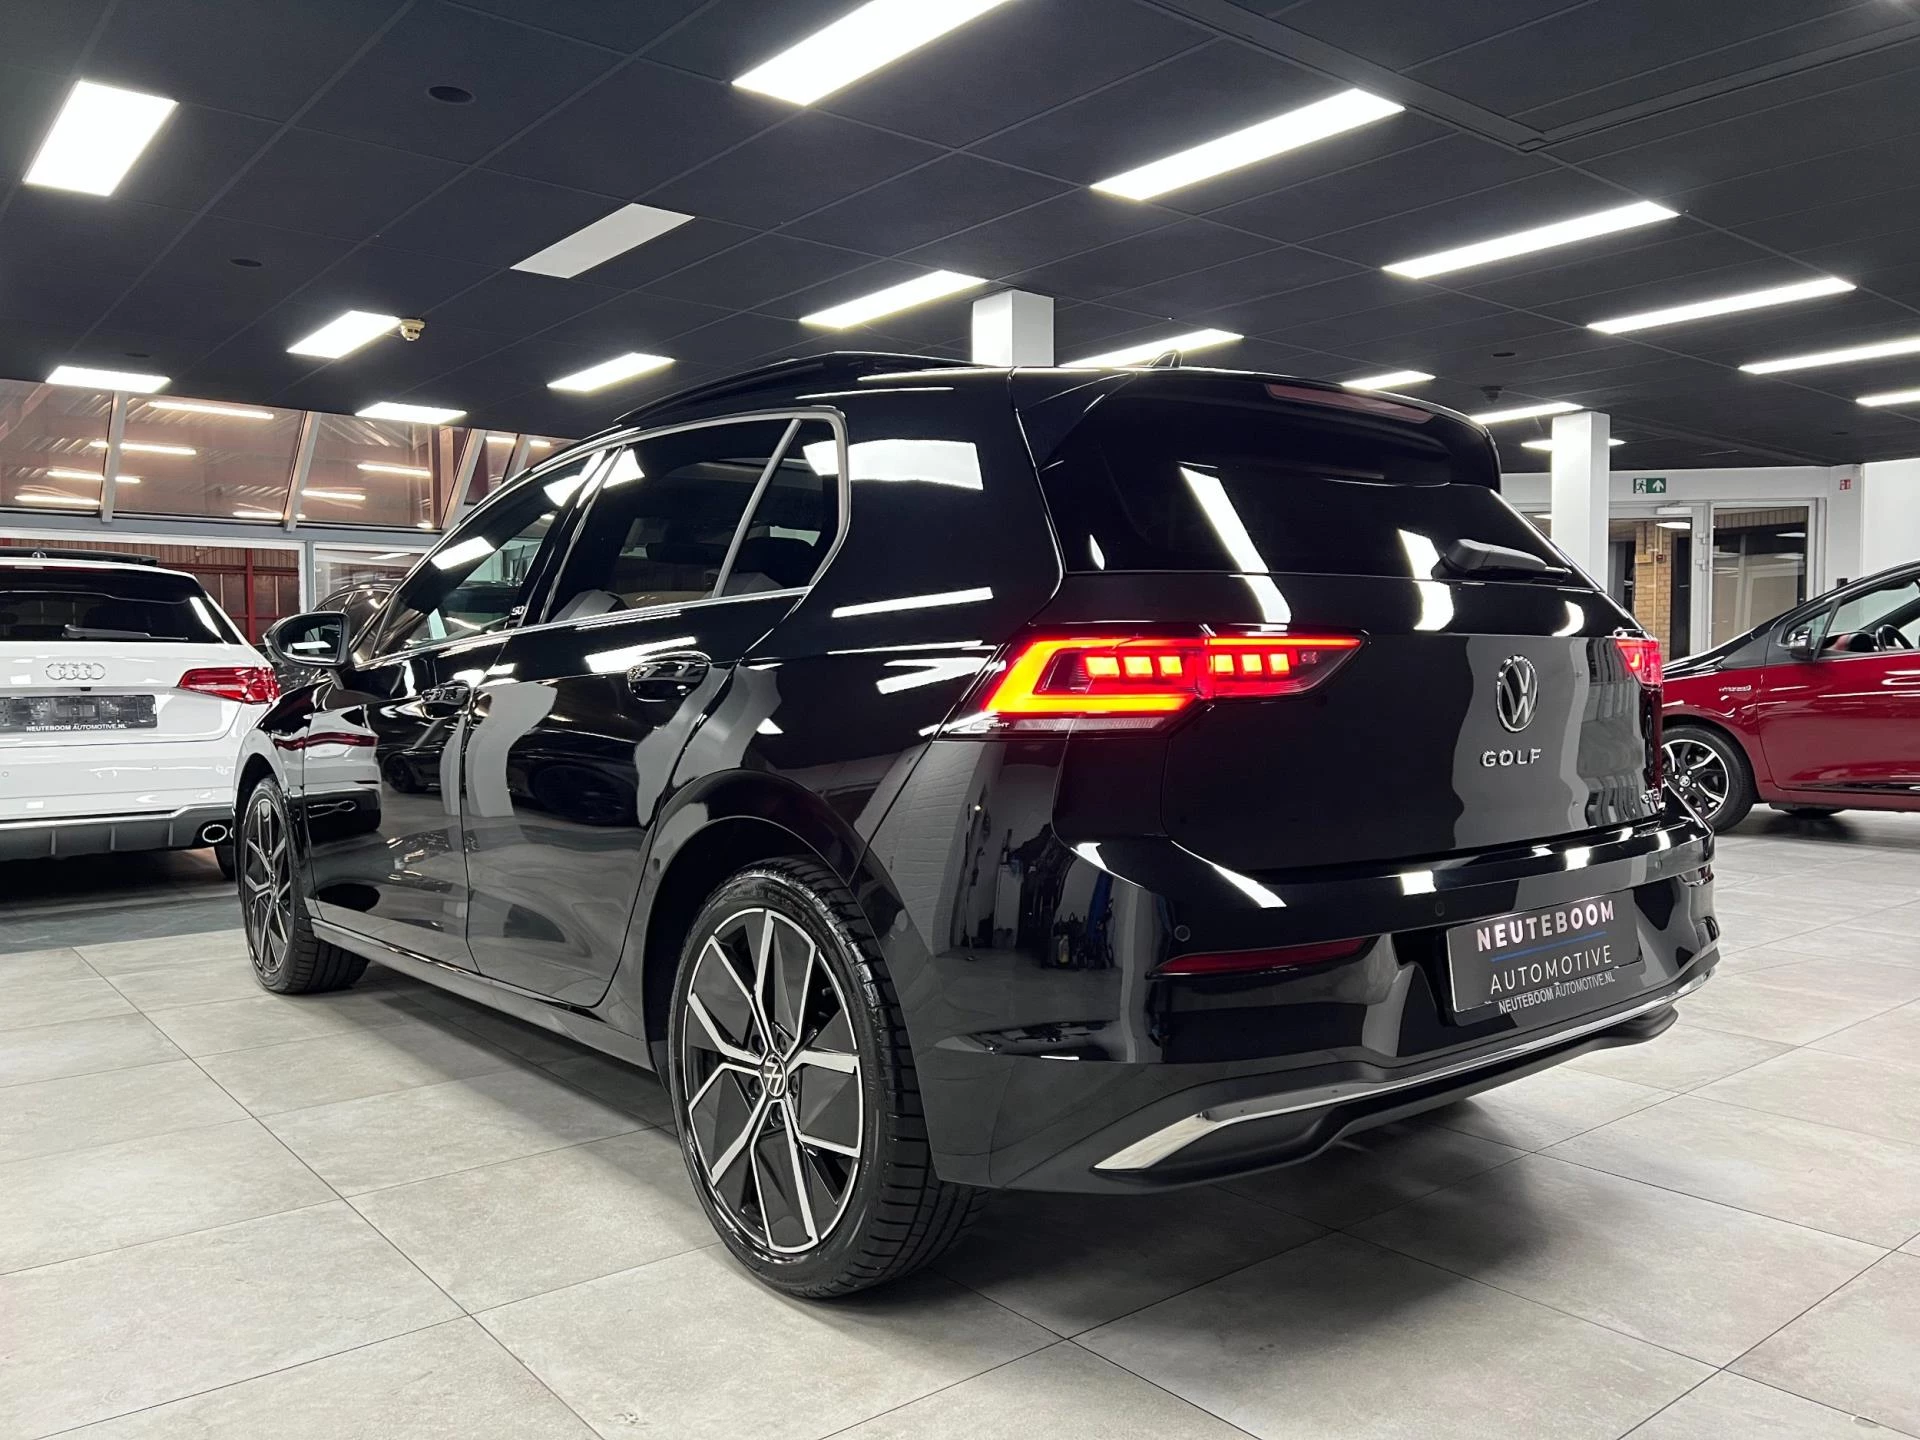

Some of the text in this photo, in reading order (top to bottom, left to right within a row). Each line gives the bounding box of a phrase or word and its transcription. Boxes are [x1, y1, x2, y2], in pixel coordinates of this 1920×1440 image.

[26, 724, 71, 732] NEUTEBOOM
[1482, 749, 1541, 767] GOLF
[1476, 900, 1614, 951] NEUTEBOOM
[1490, 945, 1612, 995] AUTOMOTIVE
[1499, 971, 1615, 1014] NEUTEBOOM AUTOMOTIVE.NL
